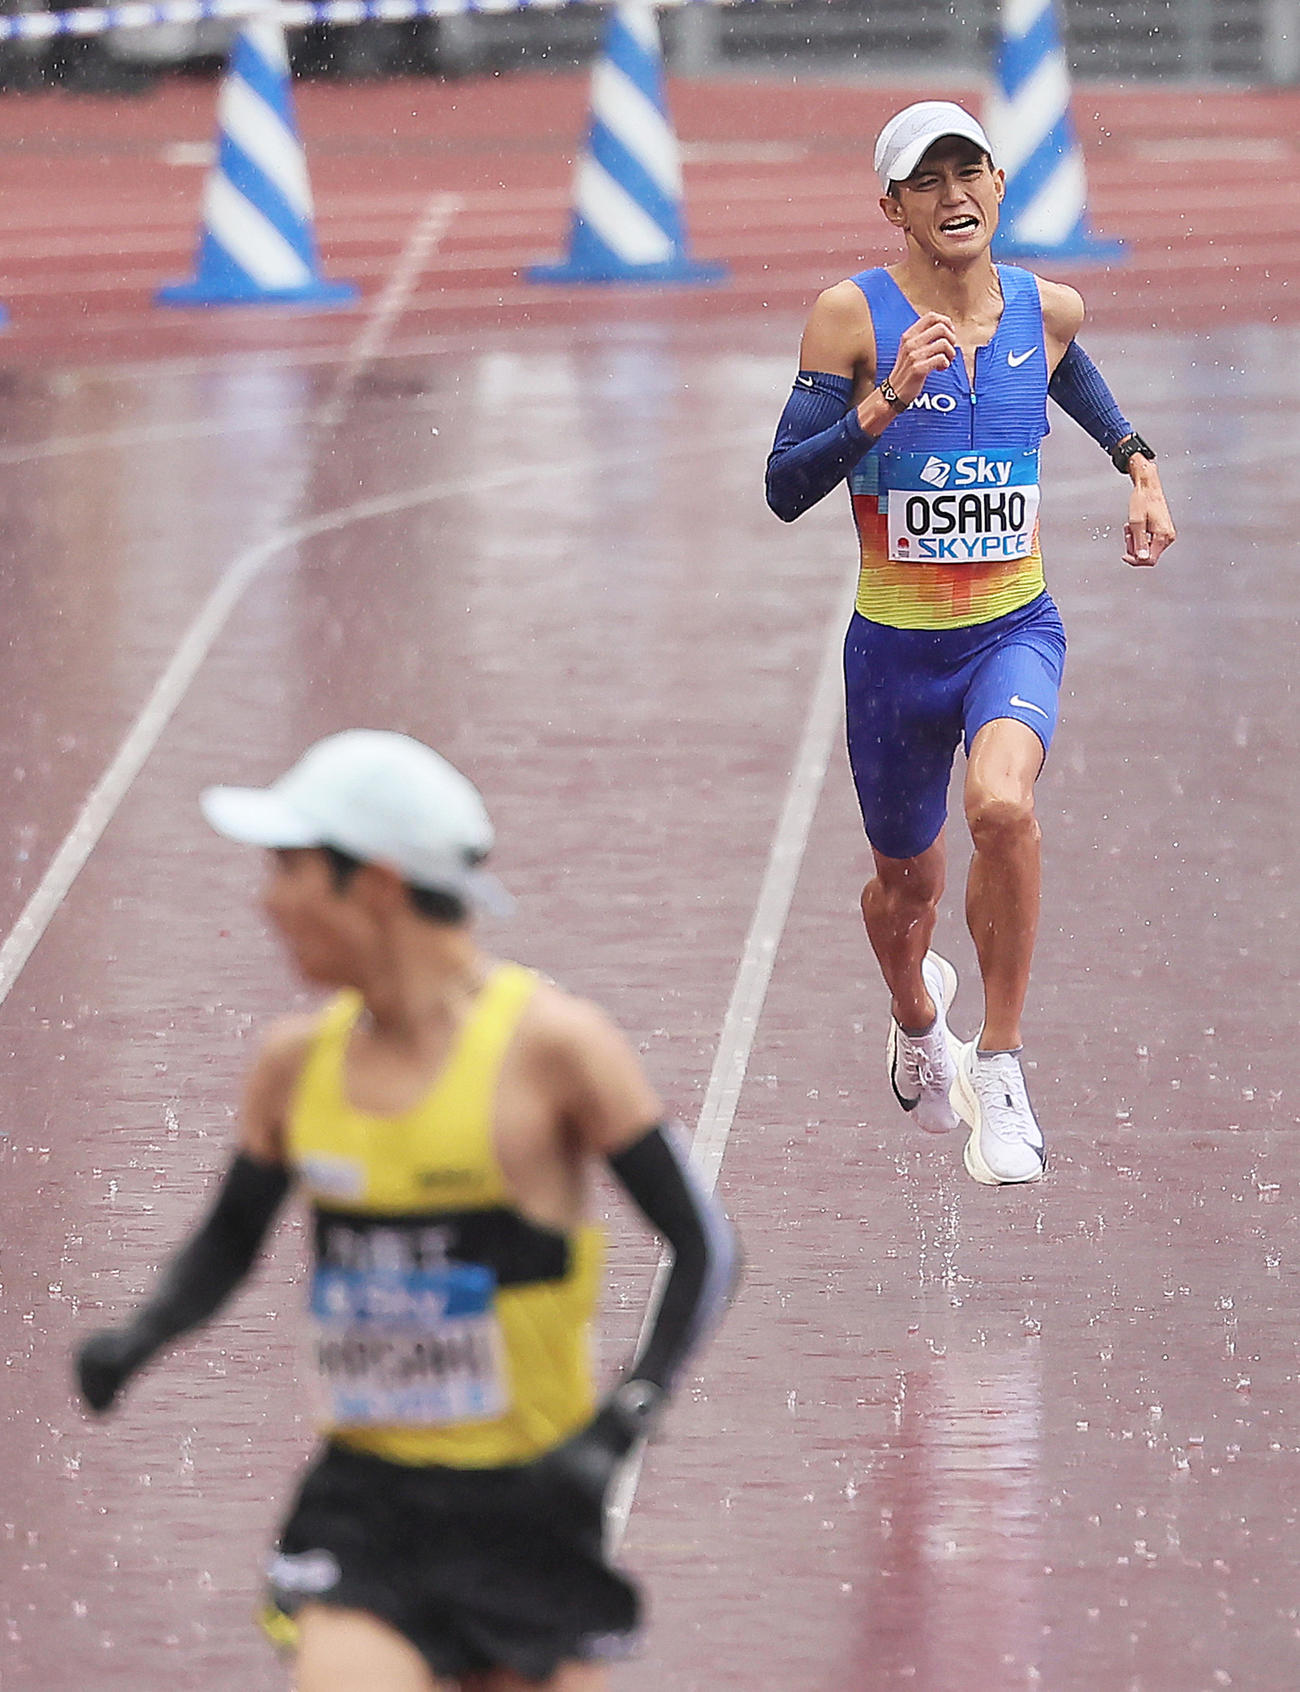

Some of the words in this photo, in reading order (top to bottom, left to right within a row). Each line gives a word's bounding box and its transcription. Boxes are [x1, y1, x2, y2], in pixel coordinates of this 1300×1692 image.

[907, 393, 957, 412] MO
[955, 456, 1013, 486] Sky
[906, 492, 1025, 535] OSAKO
[919, 533, 1028, 559] SKYPCE
